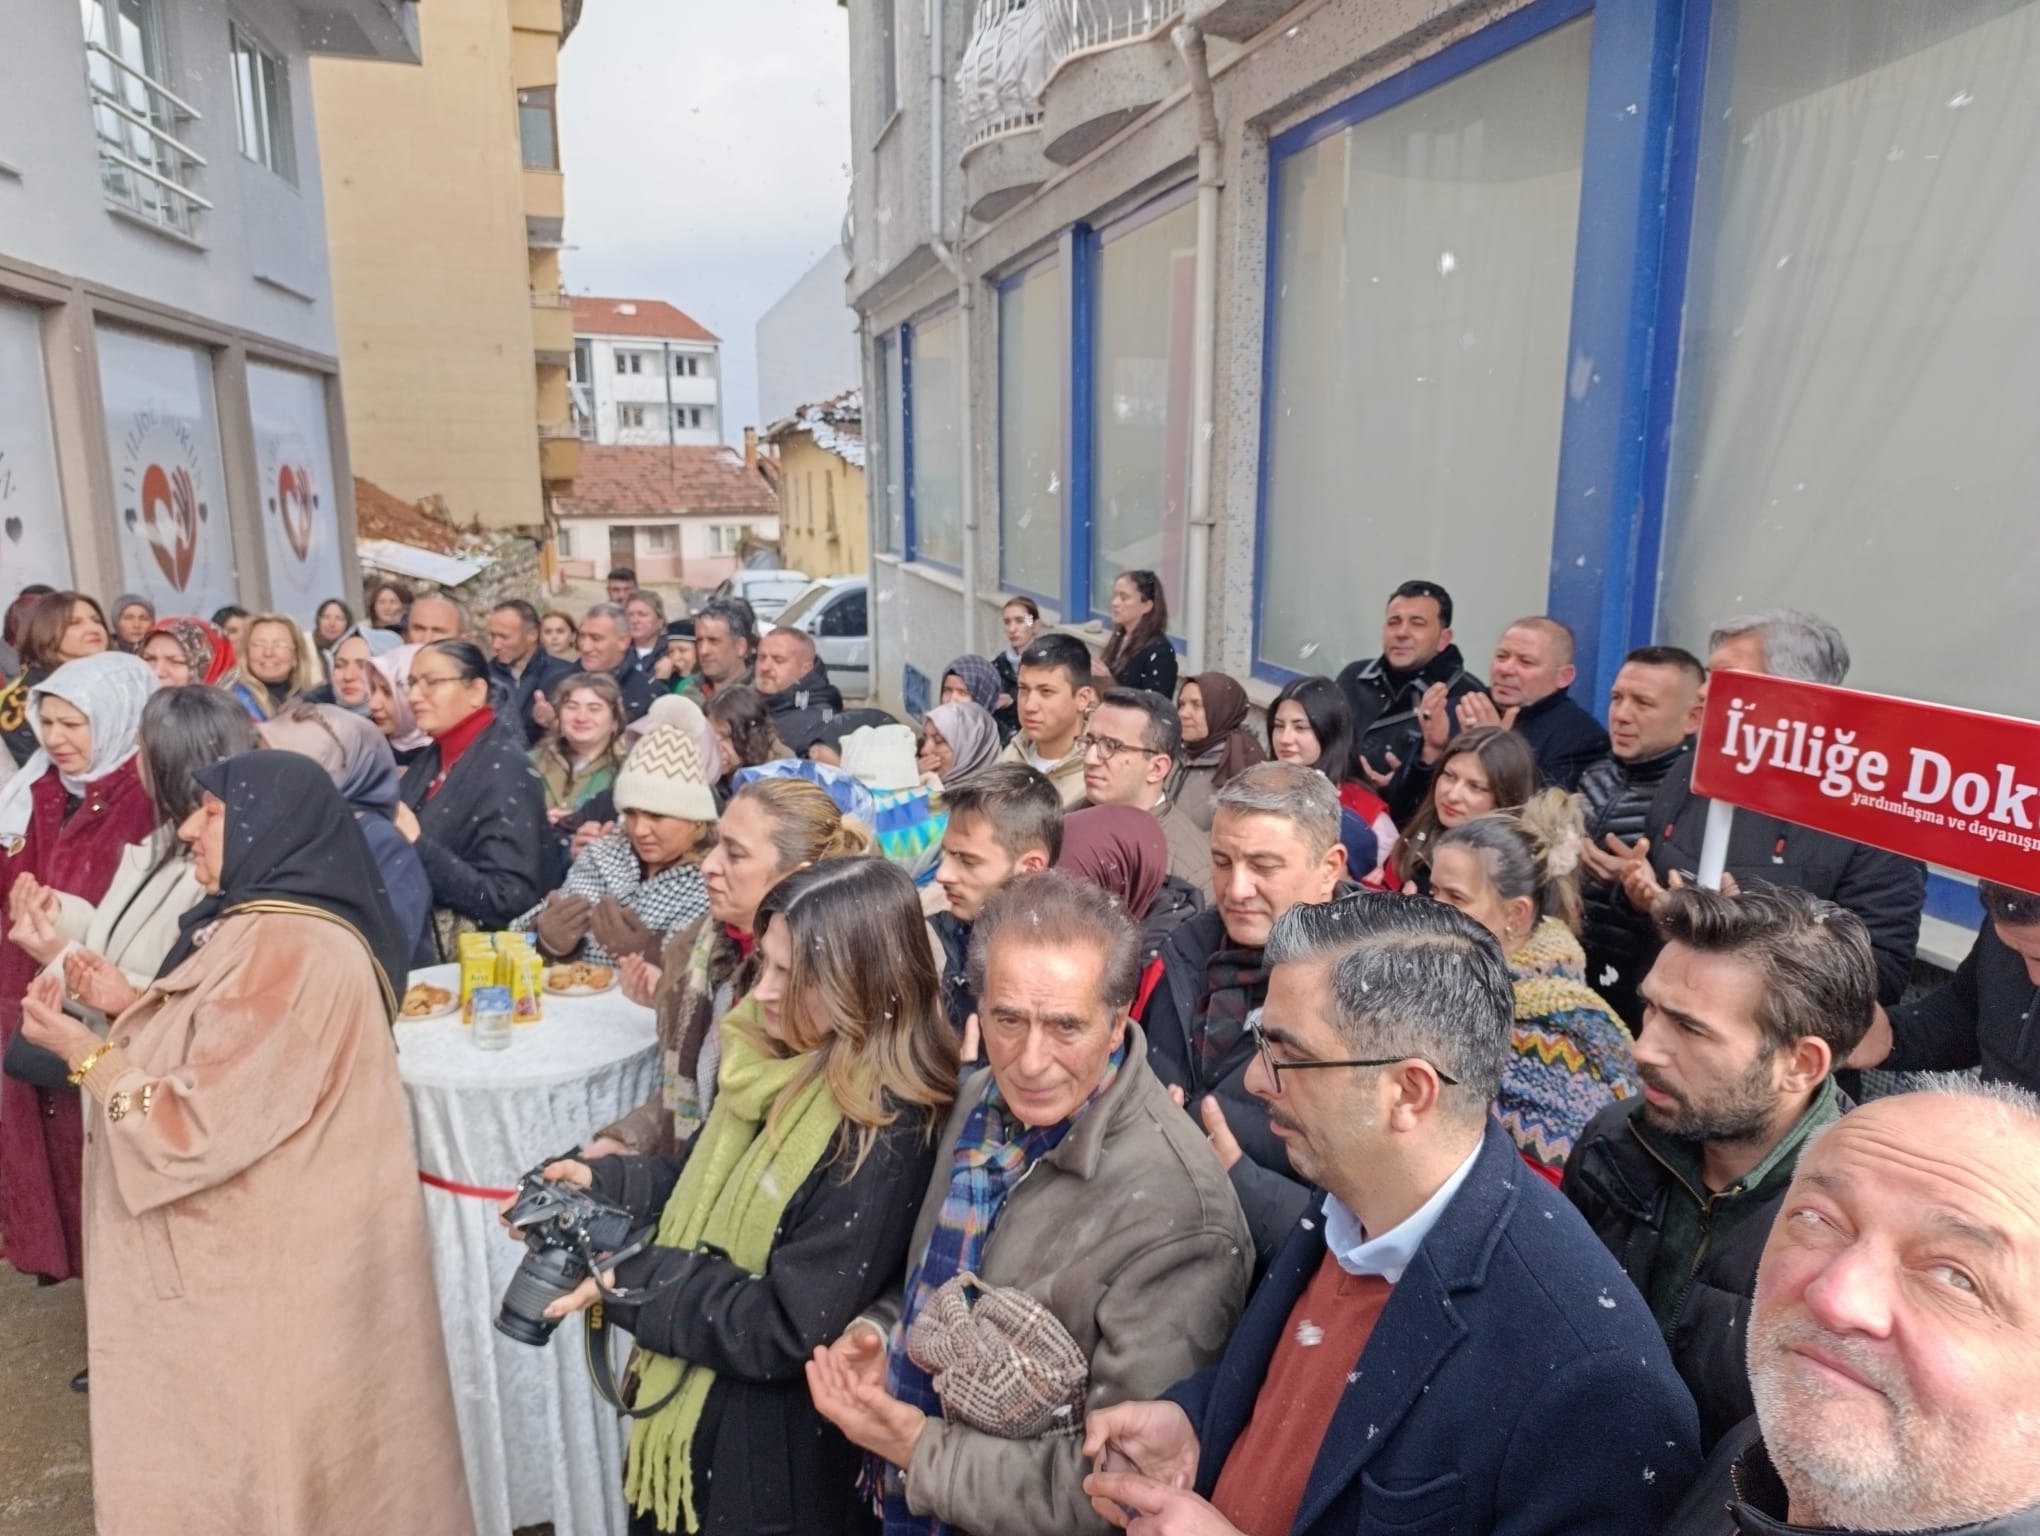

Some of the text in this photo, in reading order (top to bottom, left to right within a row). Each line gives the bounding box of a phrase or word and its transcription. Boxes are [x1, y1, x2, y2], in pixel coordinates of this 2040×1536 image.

[1721, 698, 2040, 829] İyiliğe Dok
[1851, 792, 1944, 825] yardımlaşma
[1948, 816, 1966, 831] ve
